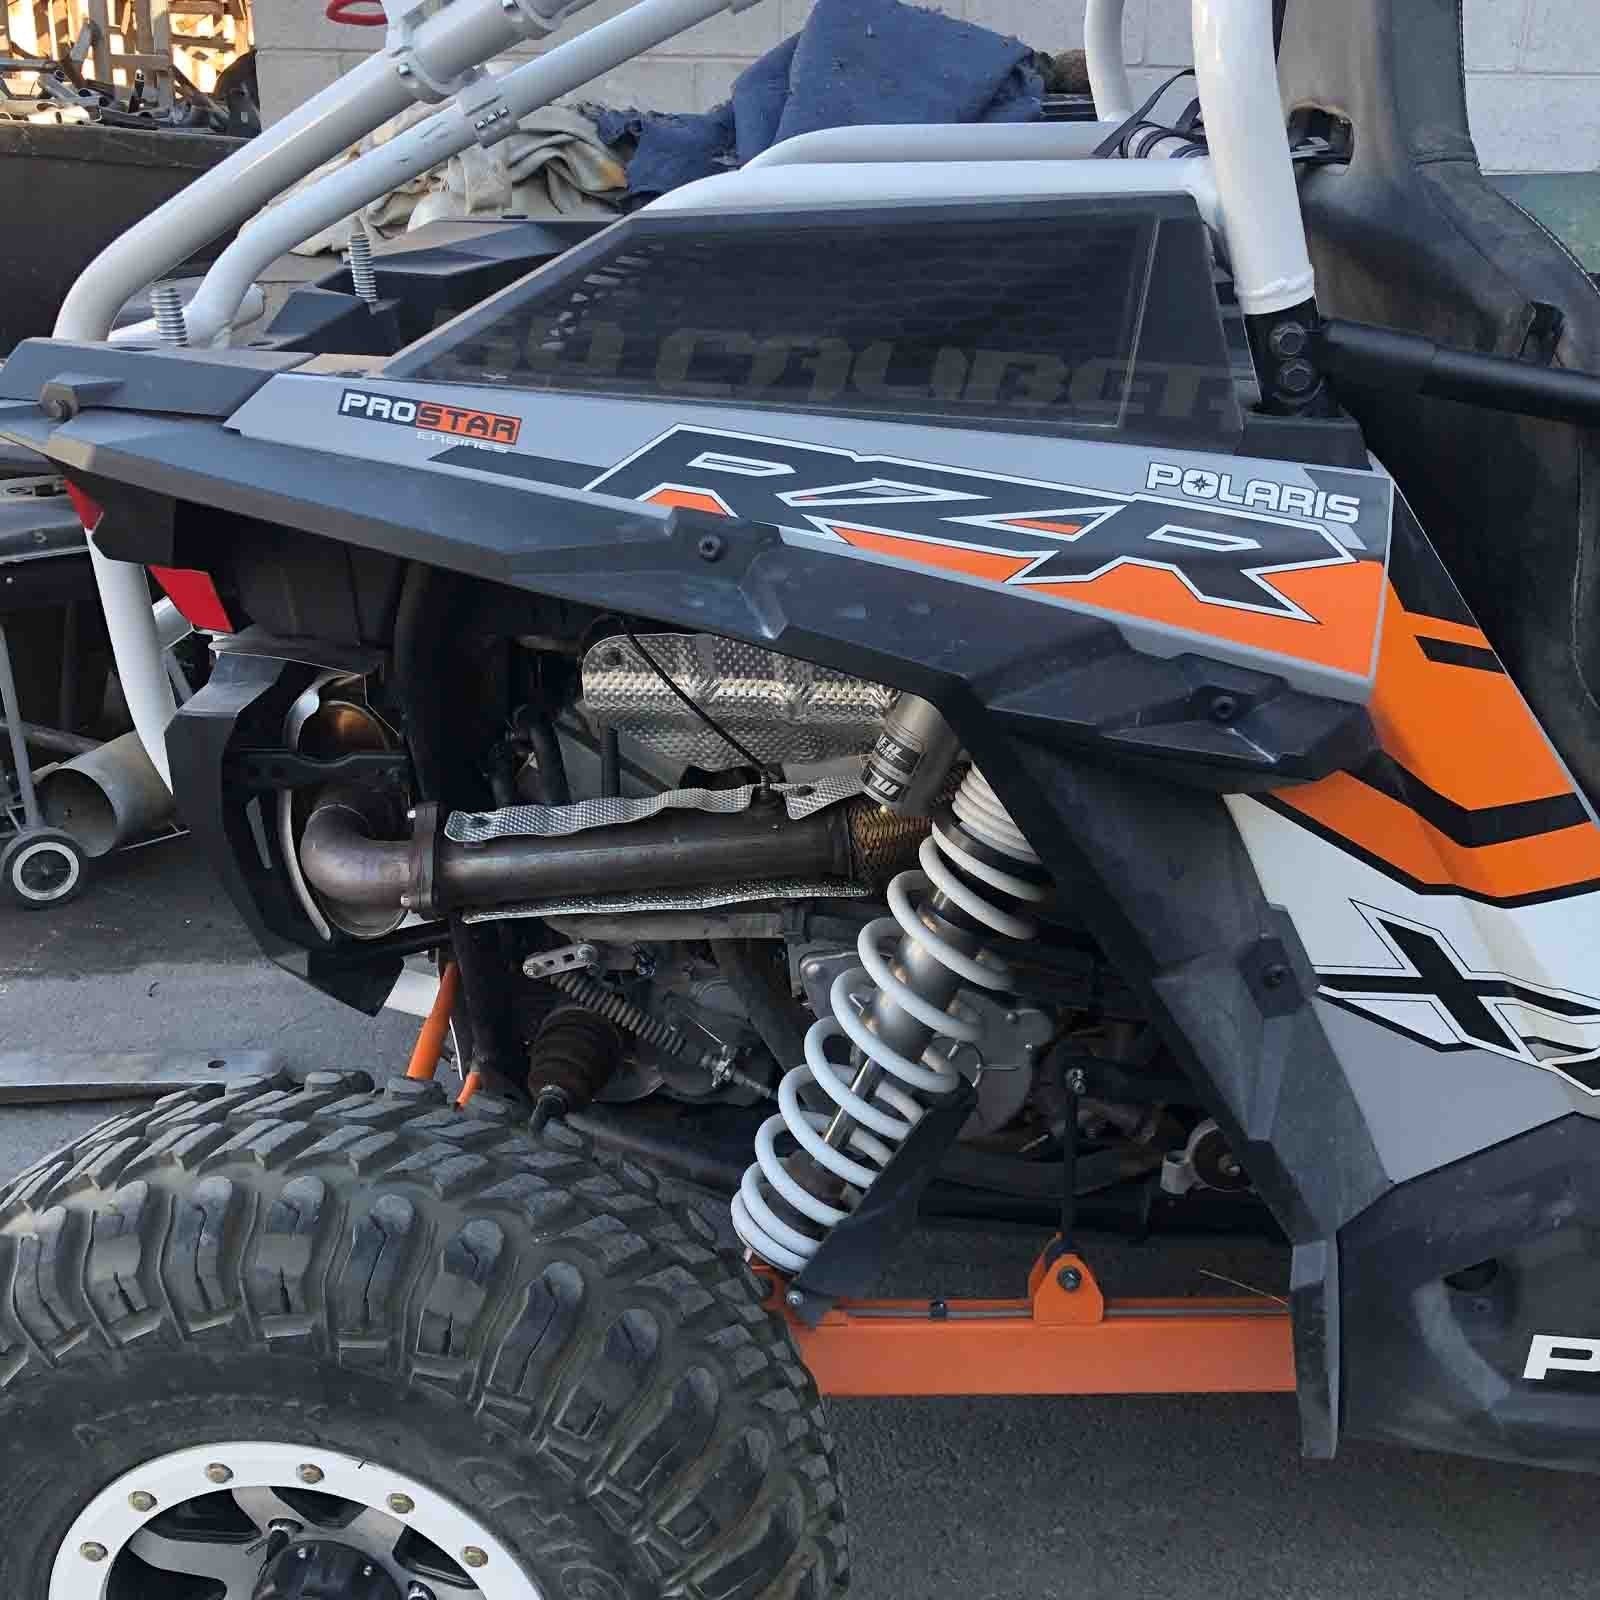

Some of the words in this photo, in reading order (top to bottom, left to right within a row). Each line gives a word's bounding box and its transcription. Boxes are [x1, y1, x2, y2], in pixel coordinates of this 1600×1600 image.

[341, 393, 516, 441] PROSTAR
[583, 423, 1359, 624] RZR
[1146, 462, 1361, 524] POLARIS
